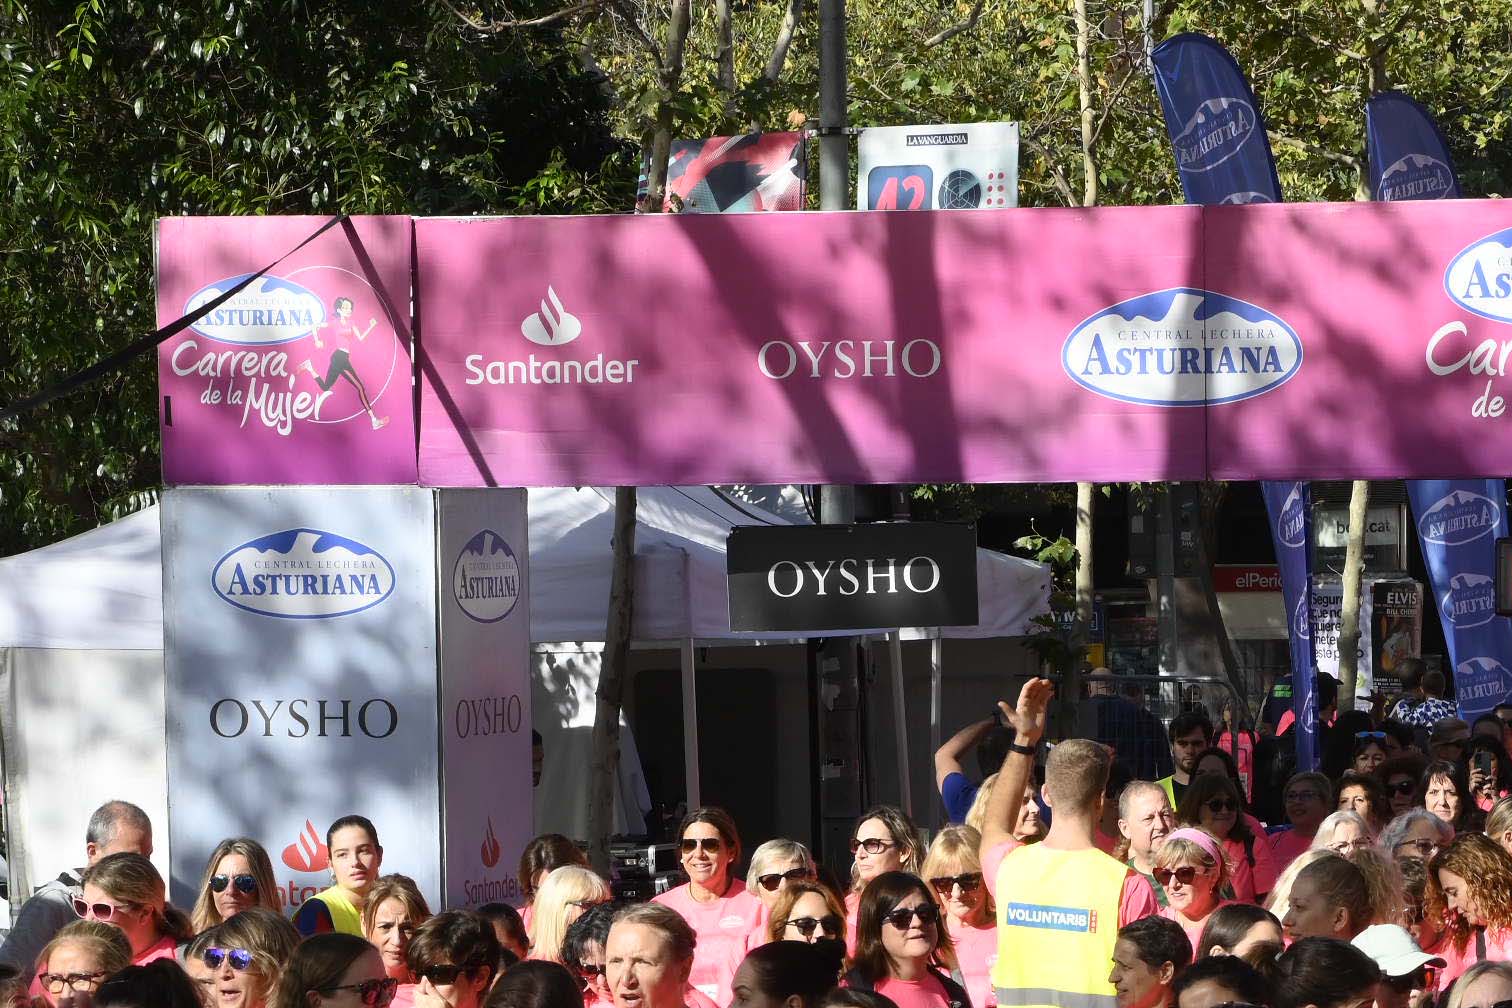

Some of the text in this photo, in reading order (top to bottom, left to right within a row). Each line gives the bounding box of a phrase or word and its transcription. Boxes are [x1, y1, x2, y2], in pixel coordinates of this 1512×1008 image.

[1117, 327, 1276, 341] CENTRAL LECHERA
[172, 340, 288, 377] Carrera
[465, 353, 639, 385] Santander
[757, 338, 941, 380] OYSHO
[1081, 332, 1284, 375] ASTURIANA
[200, 374, 333, 436] de la Mujer
[1471, 380, 1505, 418] de
[226, 562, 381, 596] ASTURIANA
[254, 560, 376, 569] CENTRAL LECHERA
[458, 566, 517, 600] ASTURIANA
[768, 556, 941, 597] OYSHO
[1386, 591, 1417, 604] ELVIS
[209, 698, 398, 738] OYSHO
[456, 694, 522, 739] OYSHO
